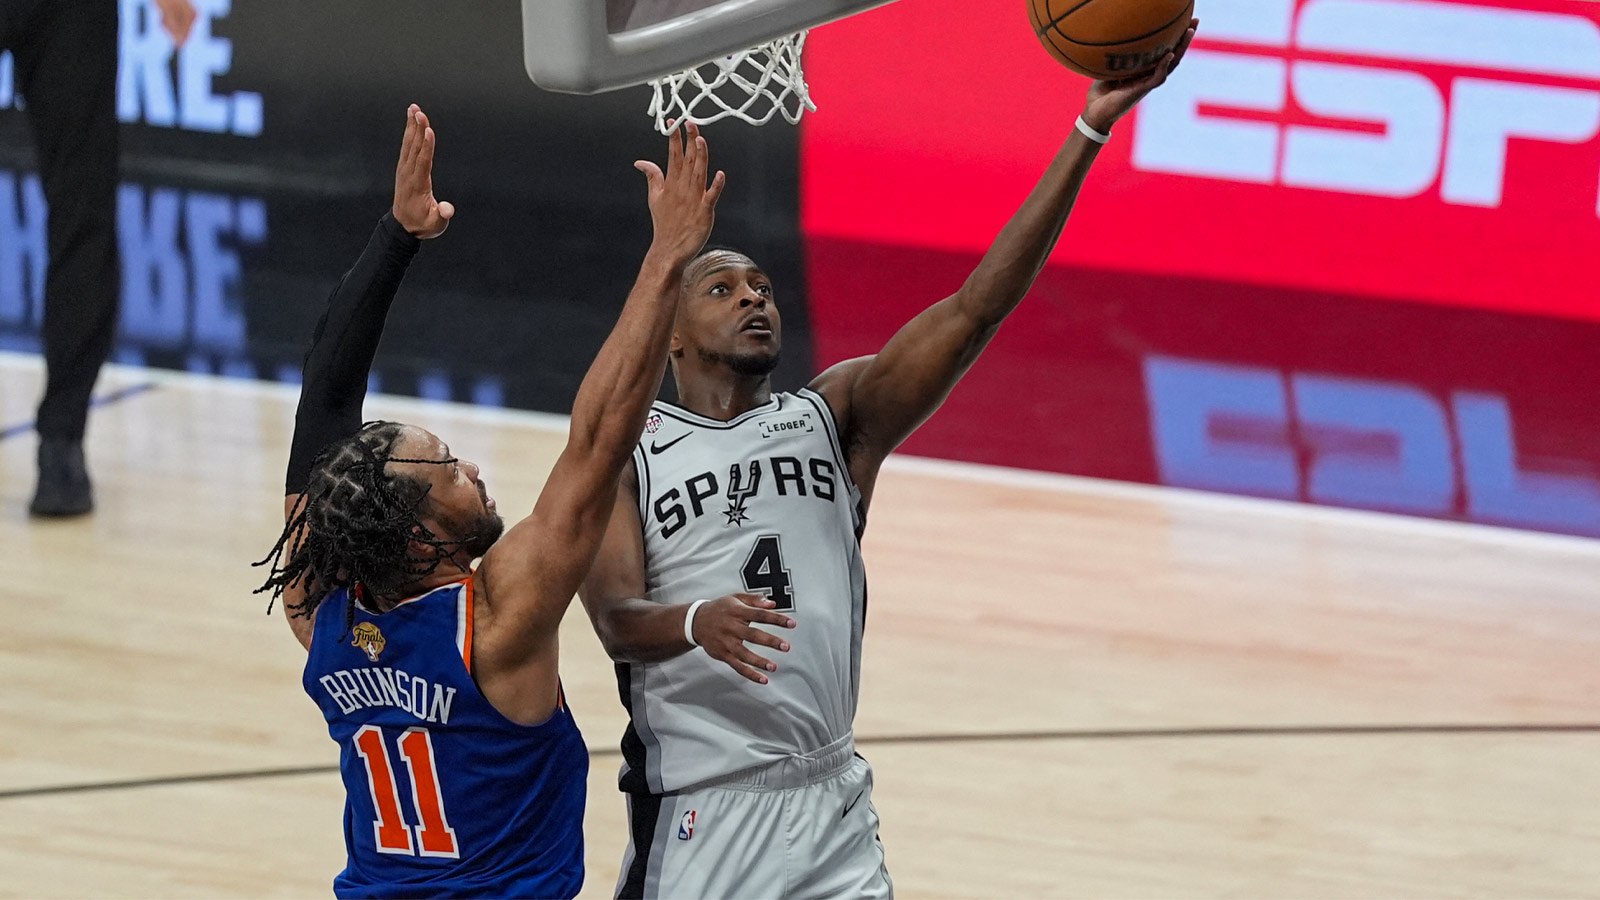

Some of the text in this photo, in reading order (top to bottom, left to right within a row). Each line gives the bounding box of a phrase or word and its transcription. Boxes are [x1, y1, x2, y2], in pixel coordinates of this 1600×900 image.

[1132, 0, 1600, 218] ESP
[766, 419, 806, 433] LEDGER
[653, 456, 836, 541] SPURS
[739, 533, 797, 613] 4
[352, 627, 385, 645] Finals
[319, 667, 457, 725] BRUNSON
[352, 724, 460, 859] 11
